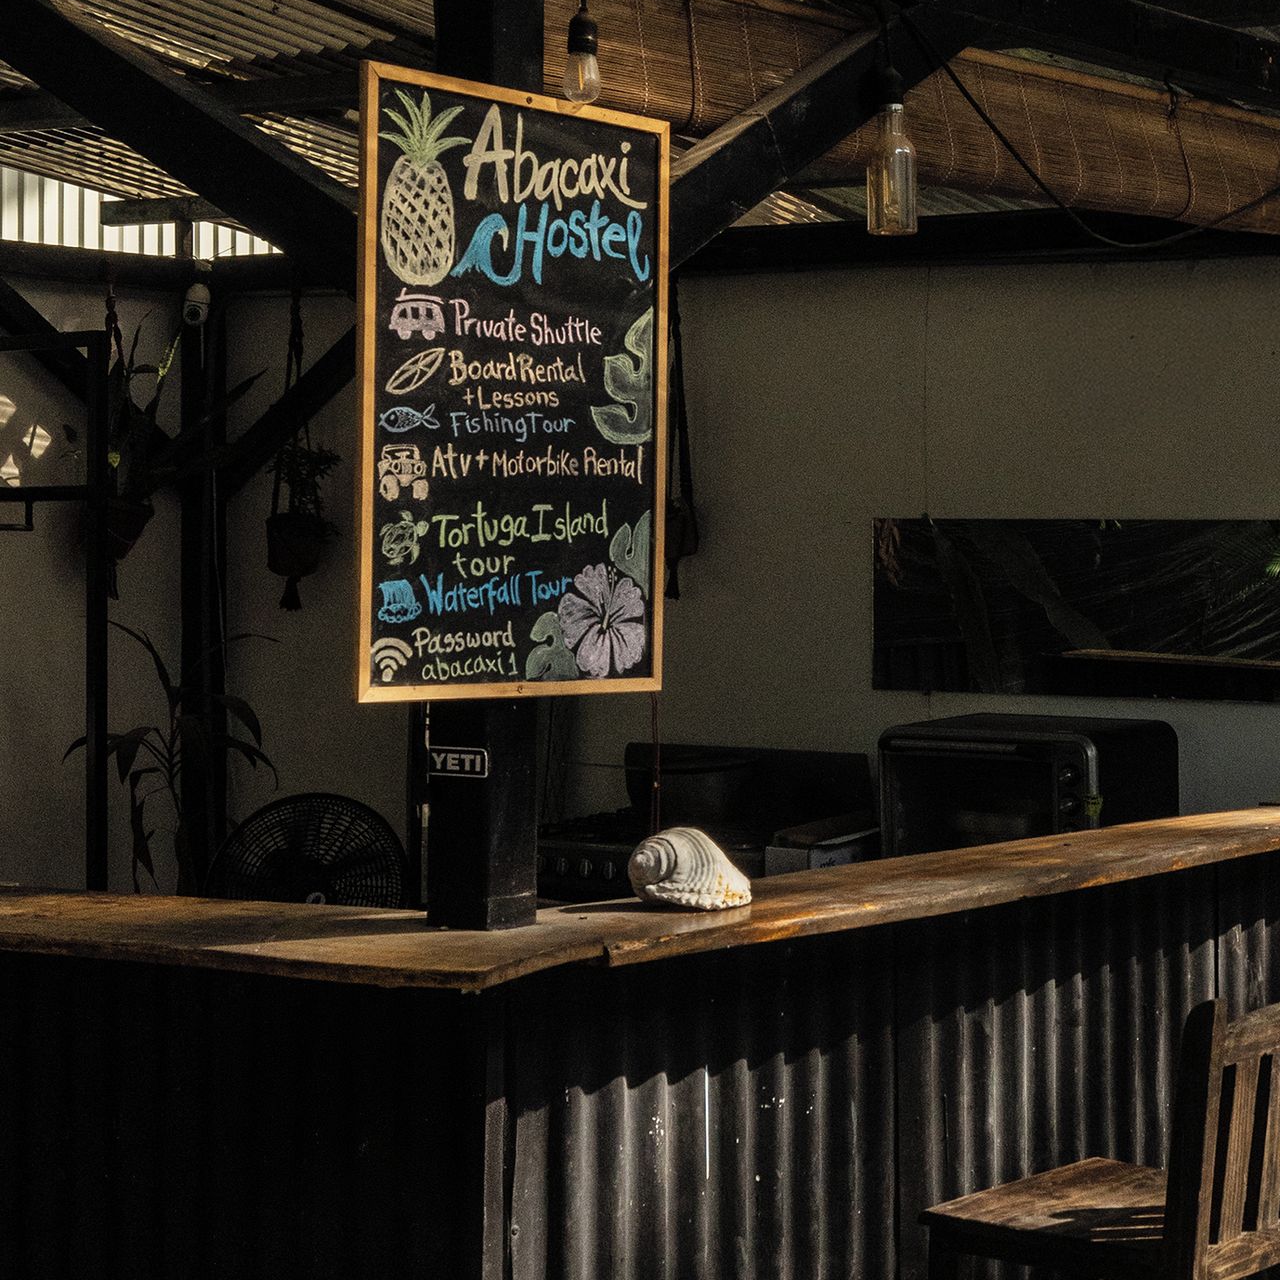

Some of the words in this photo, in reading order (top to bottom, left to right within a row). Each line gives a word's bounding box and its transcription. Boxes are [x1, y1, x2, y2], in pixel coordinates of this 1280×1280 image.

[463, 103, 647, 211] Abacaxi
[490, 200, 650, 286] Hostel
[450, 299, 527, 344] Private
[530, 309, 602, 346] Shuttle
[450, 410, 530, 442] Fishing
[530, 412, 576, 433] Tour
[583, 445, 643, 484] Rental
[431, 501, 529, 549] Tortuga
[530, 498, 609, 543] Island
[452, 552, 515, 579] tour
[420, 572, 521, 616] Waterfall
[527, 570, 573, 608] Tour
[411, 621, 517, 657] Password
[431, 750, 482, 773] YETI
